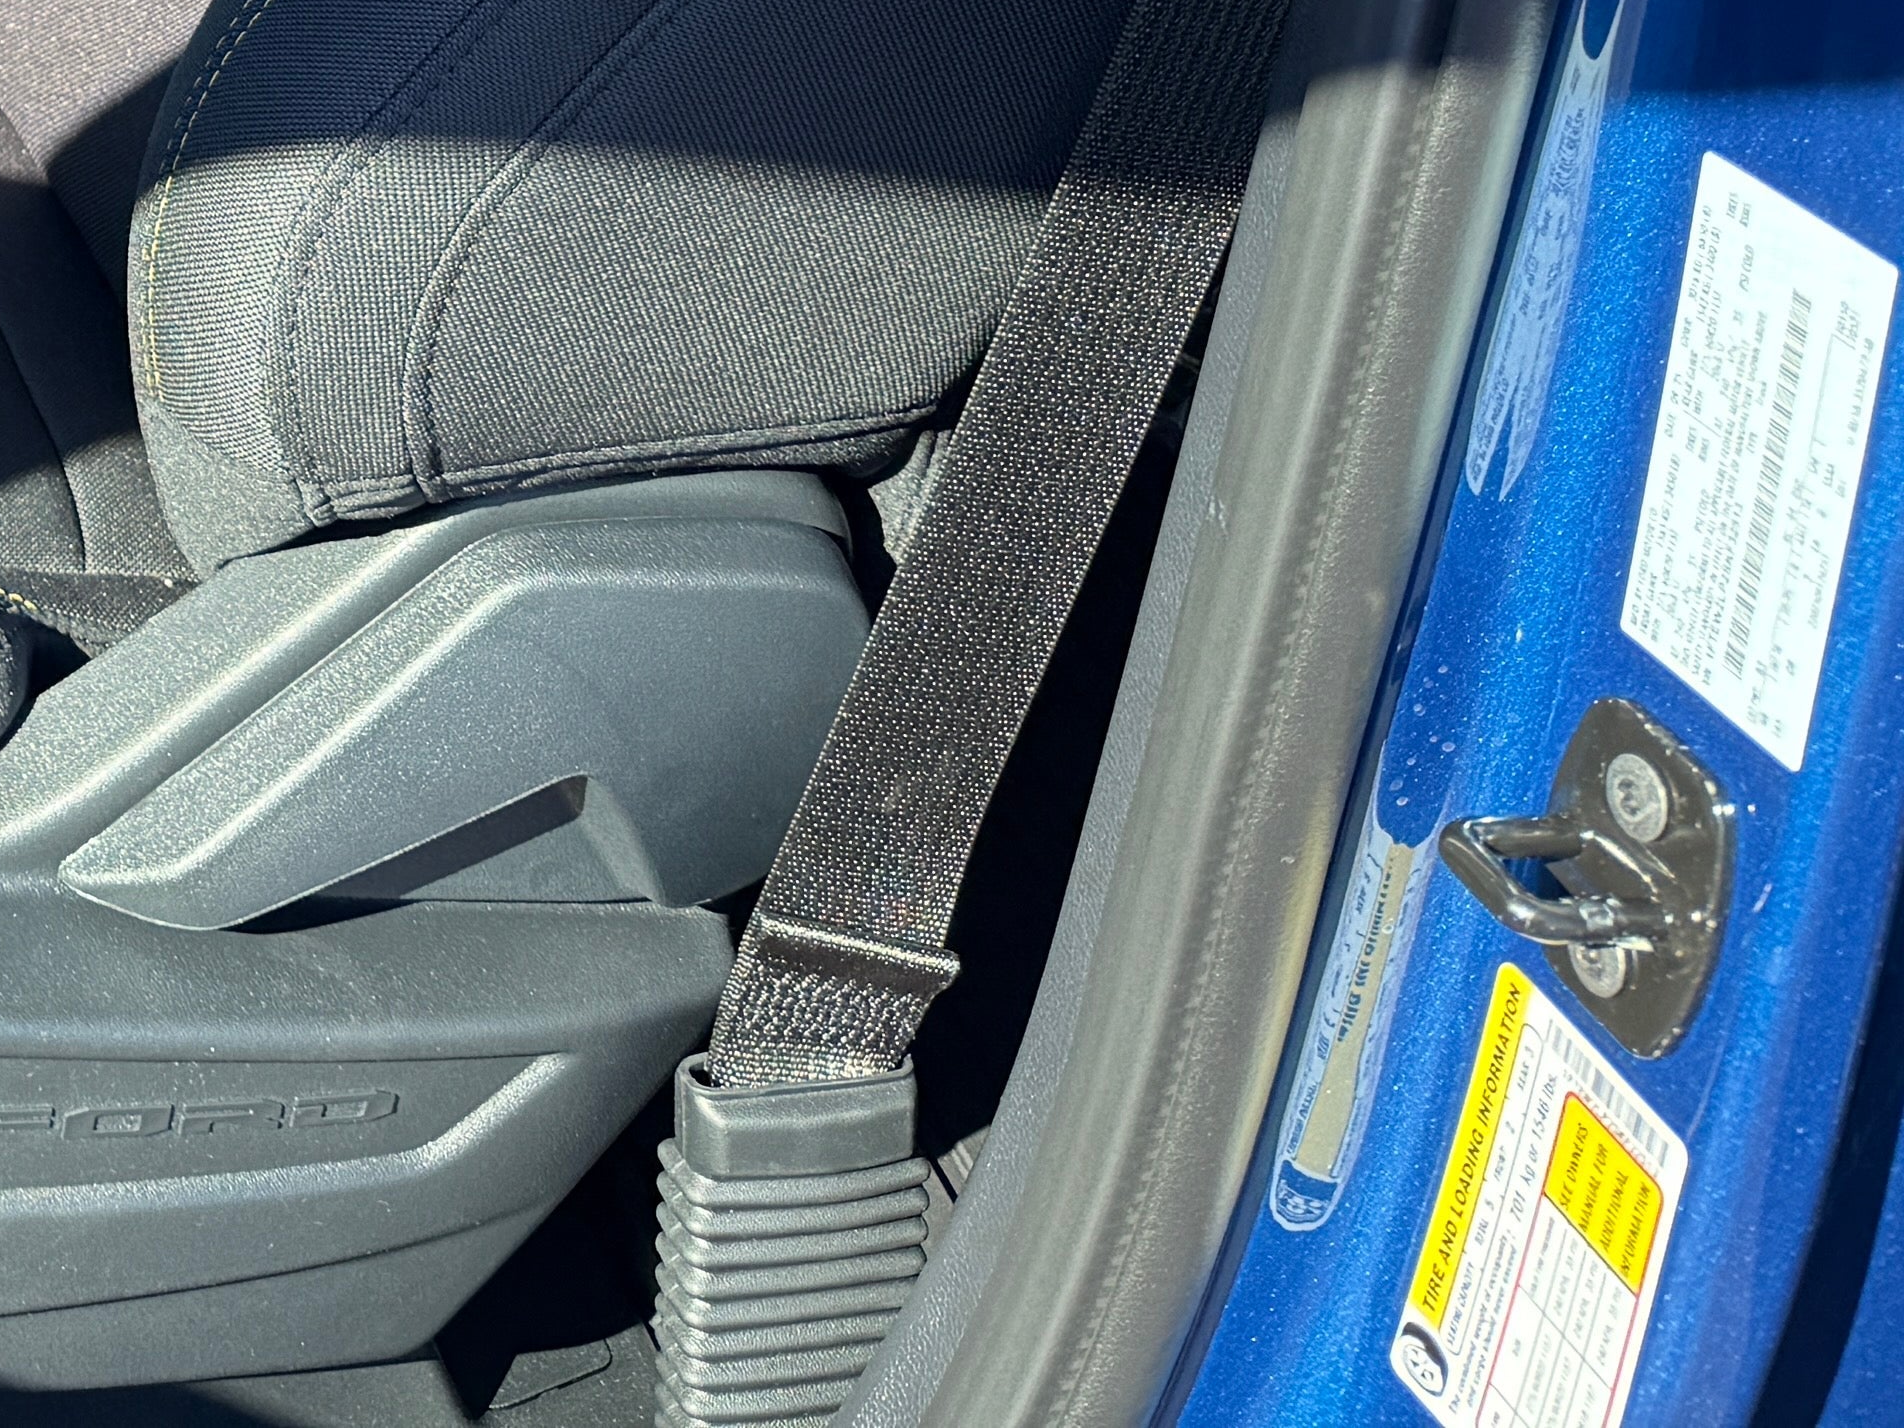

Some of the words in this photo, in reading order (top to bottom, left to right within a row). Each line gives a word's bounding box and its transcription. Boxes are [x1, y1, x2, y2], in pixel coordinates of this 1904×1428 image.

[1422, 1261, 1445, 1314] TIRE
[1436, 1216, 1458, 1265] AND
[1450, 1125, 1484, 1220] LOADING
[1474, 981, 1524, 1128] INFORMATION
[1576, 1171, 1601, 1234] MANUAL
[1592, 1141, 1608, 1174] FOR
[1597, 1166, 1629, 1252] ADDITIONAL
[1617, 1181, 1651, 1278] INFORMATION
